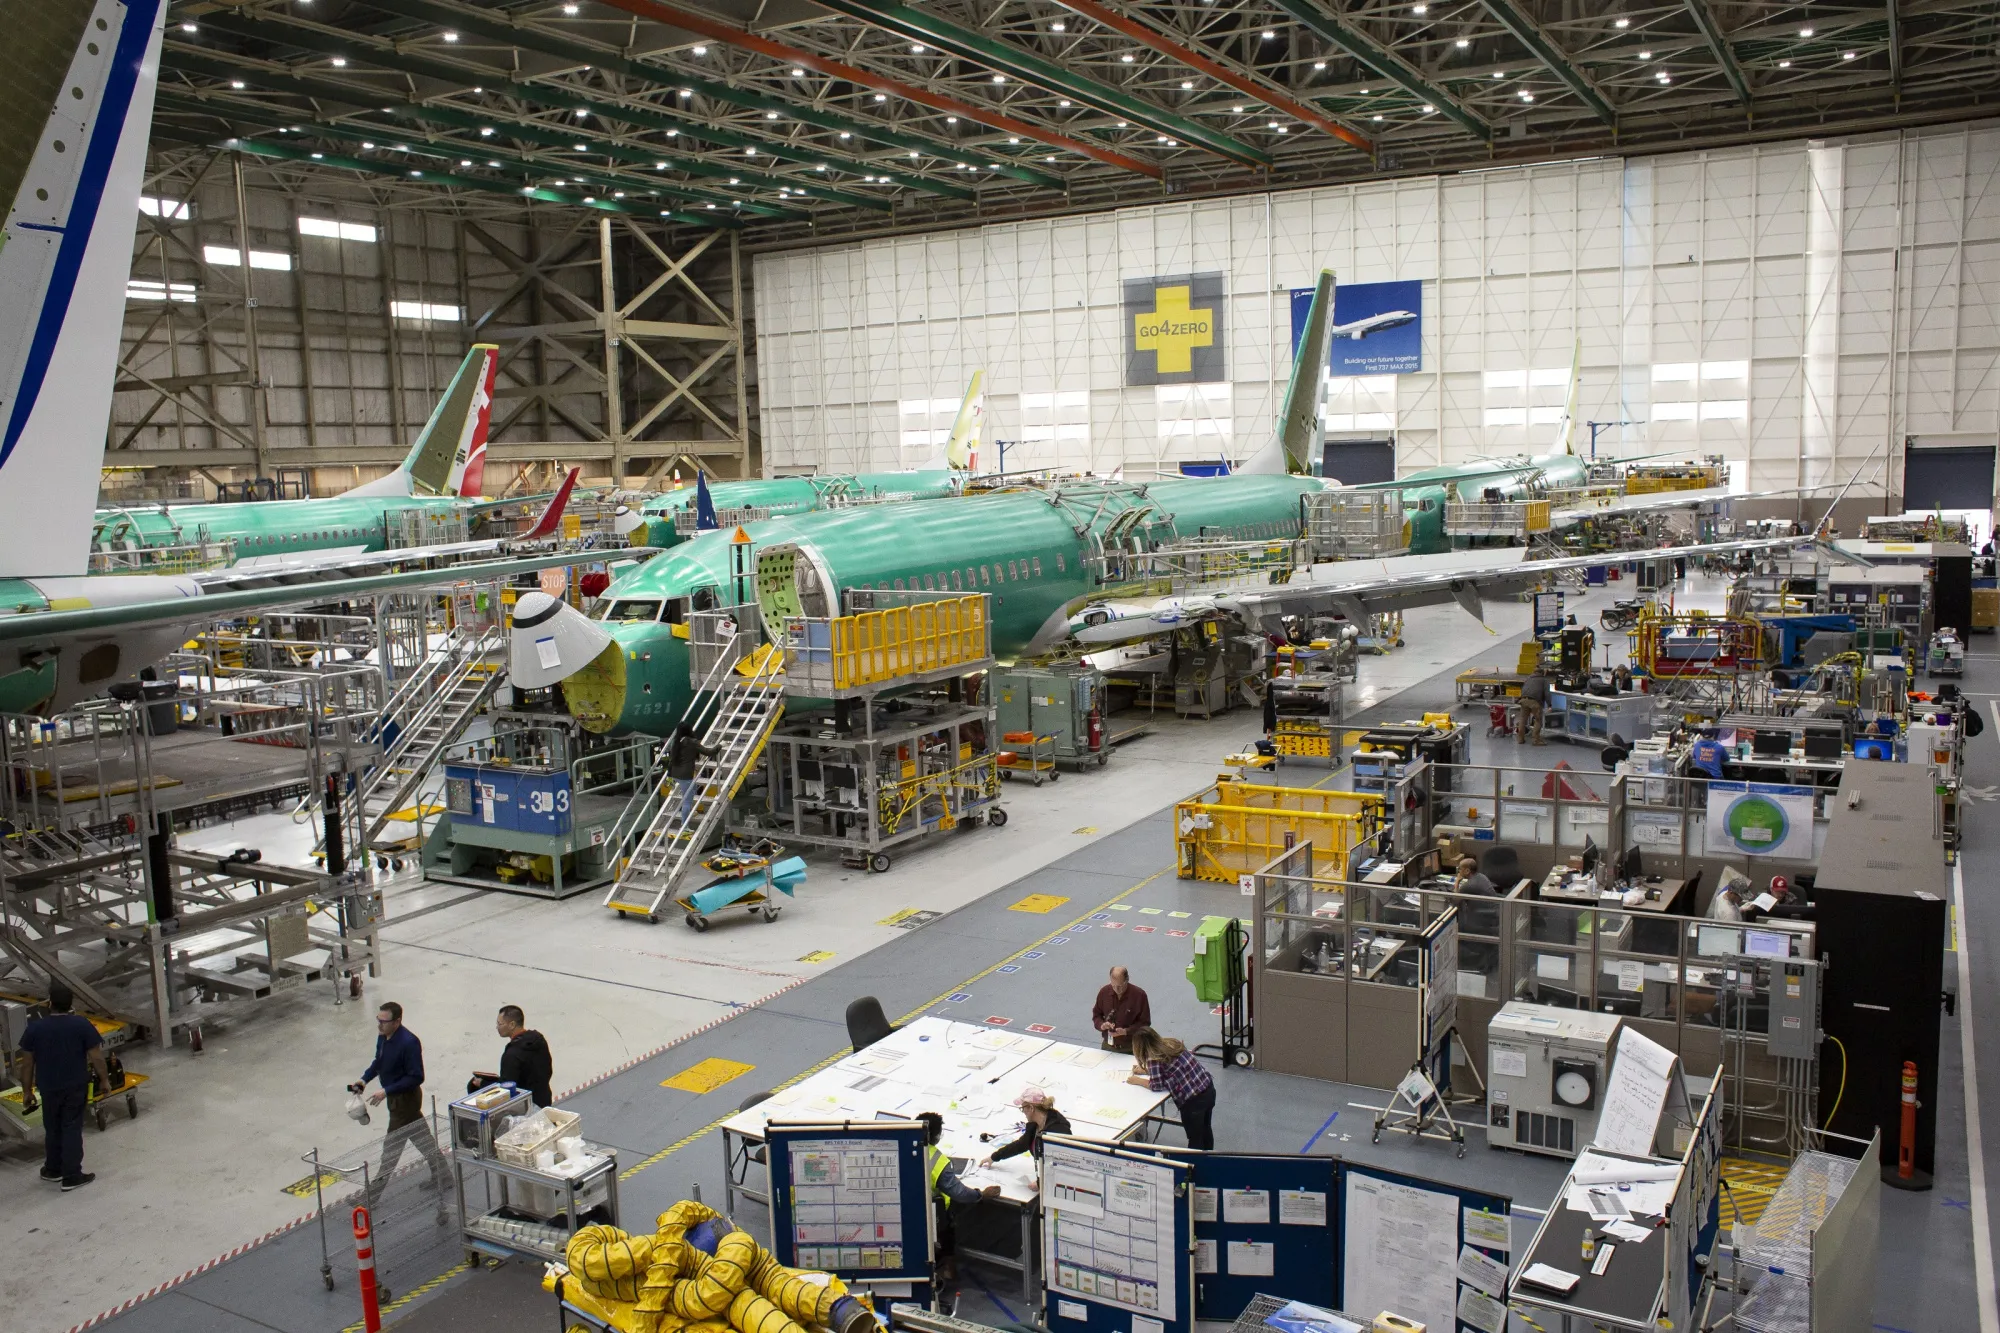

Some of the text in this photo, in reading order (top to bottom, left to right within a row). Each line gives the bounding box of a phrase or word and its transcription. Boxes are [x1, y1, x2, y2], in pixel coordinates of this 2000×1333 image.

[1139, 319, 1209, 338] GO4ZERO
[1394, 355, 1419, 363] together
[1404, 362, 1419, 370] 2015
[542, 574, 566, 589] STOP
[1740, 1183, 1771, 1193] CLEAR
[906, 1307, 936, 1319] ONLY
[936, 1315, 974, 1329] LINES
